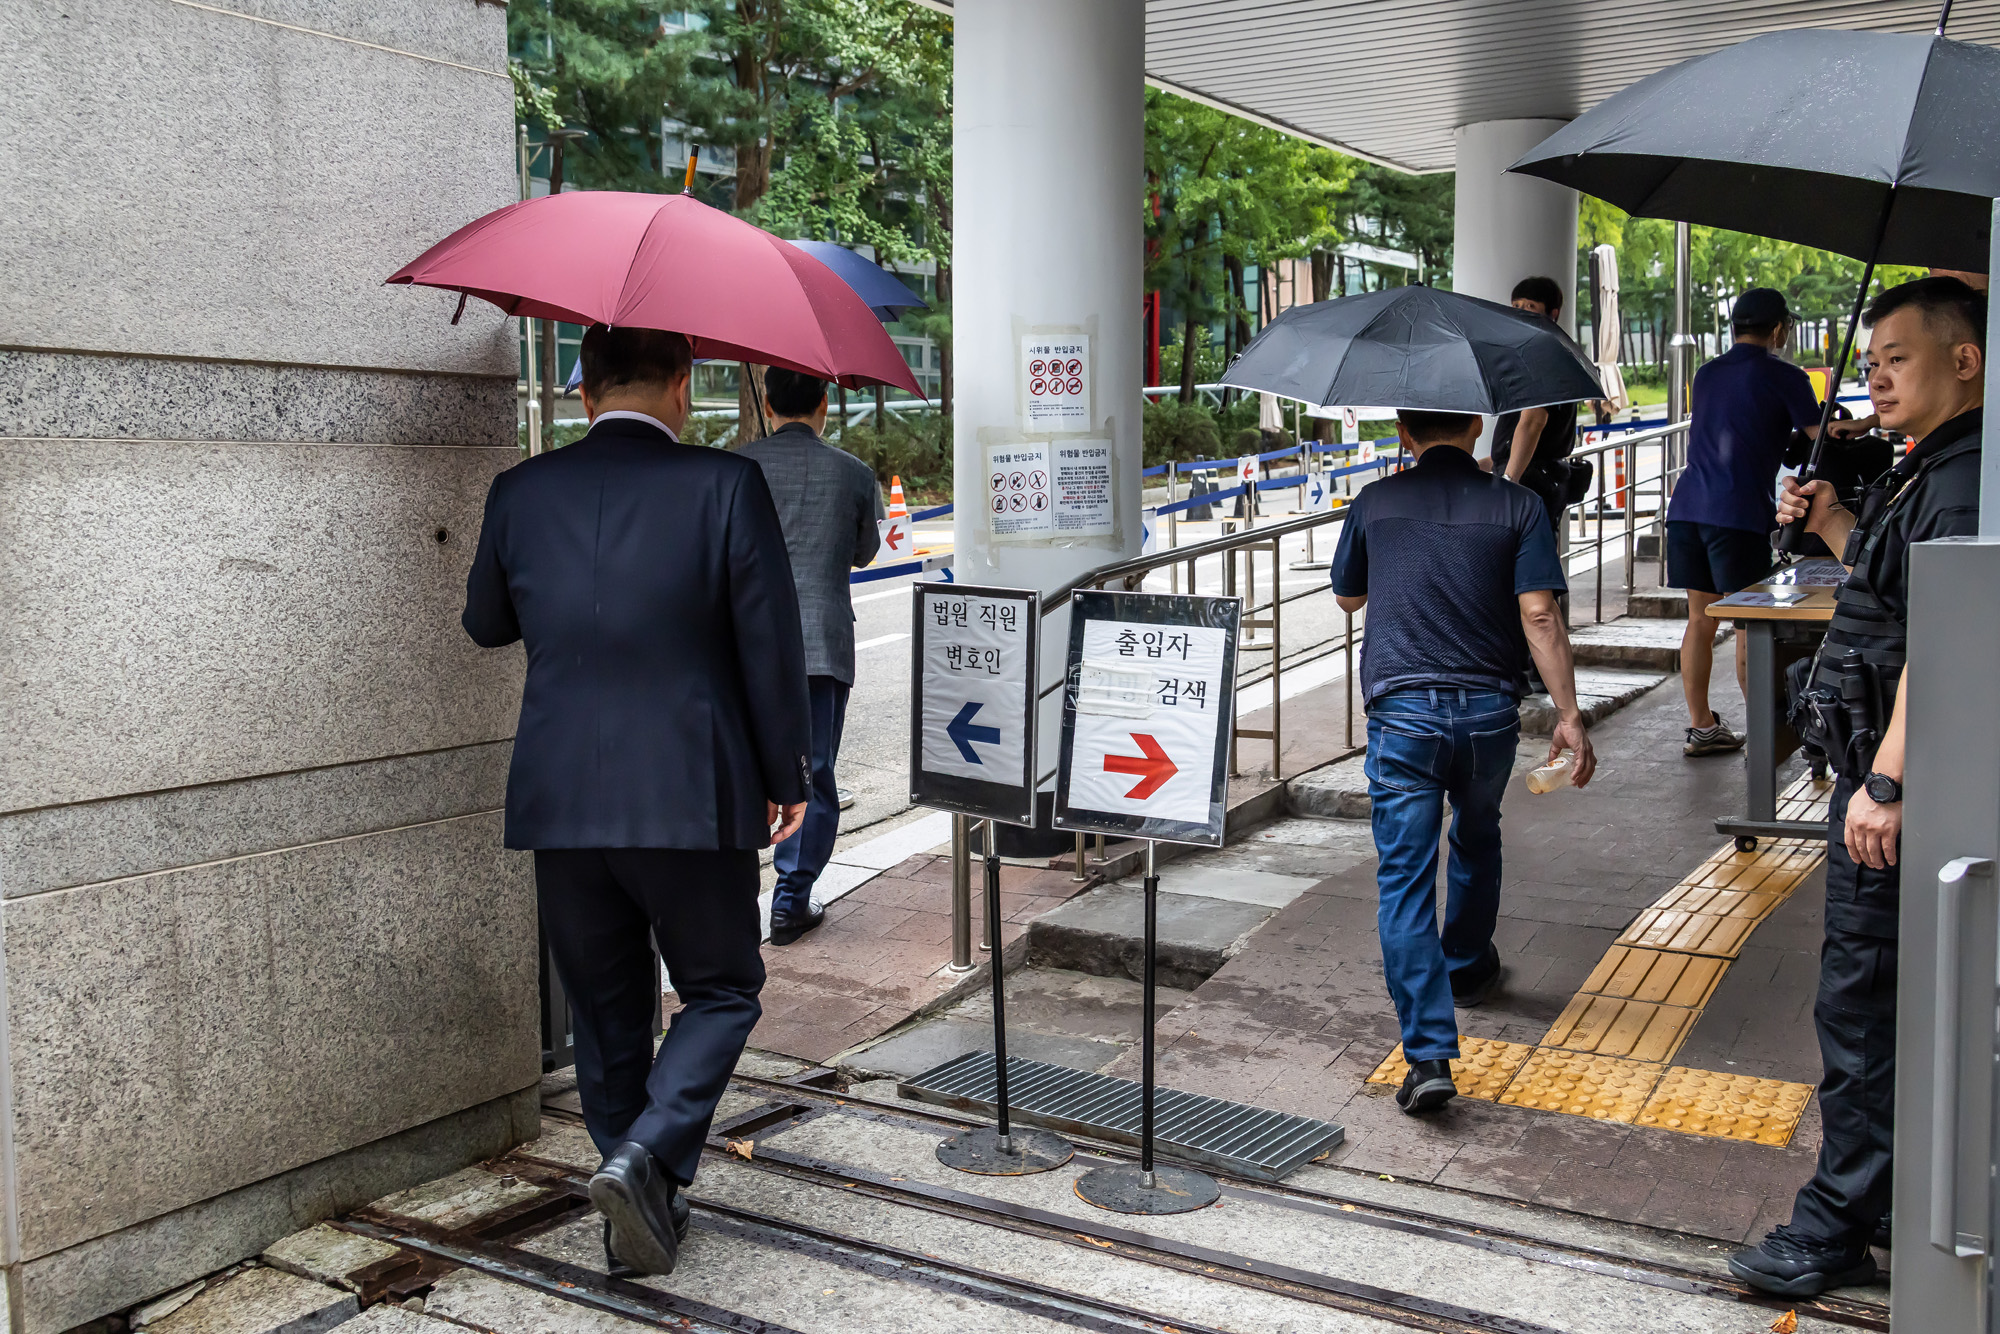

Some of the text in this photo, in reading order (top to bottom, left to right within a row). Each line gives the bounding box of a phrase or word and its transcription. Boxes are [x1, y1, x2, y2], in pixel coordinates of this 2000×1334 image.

[1029, 345, 1083, 355] 시위물 반입금지
[992, 452, 1042, 463] 위험물 반입금지
[1059, 448, 1107, 458] 위험물 반입금지
[932, 600, 1017, 632] 법원 직원
[1114, 628, 1193, 661] 출입자
[946, 645, 1001, 675] 변호인
[1156, 678, 1207, 709] 검색
